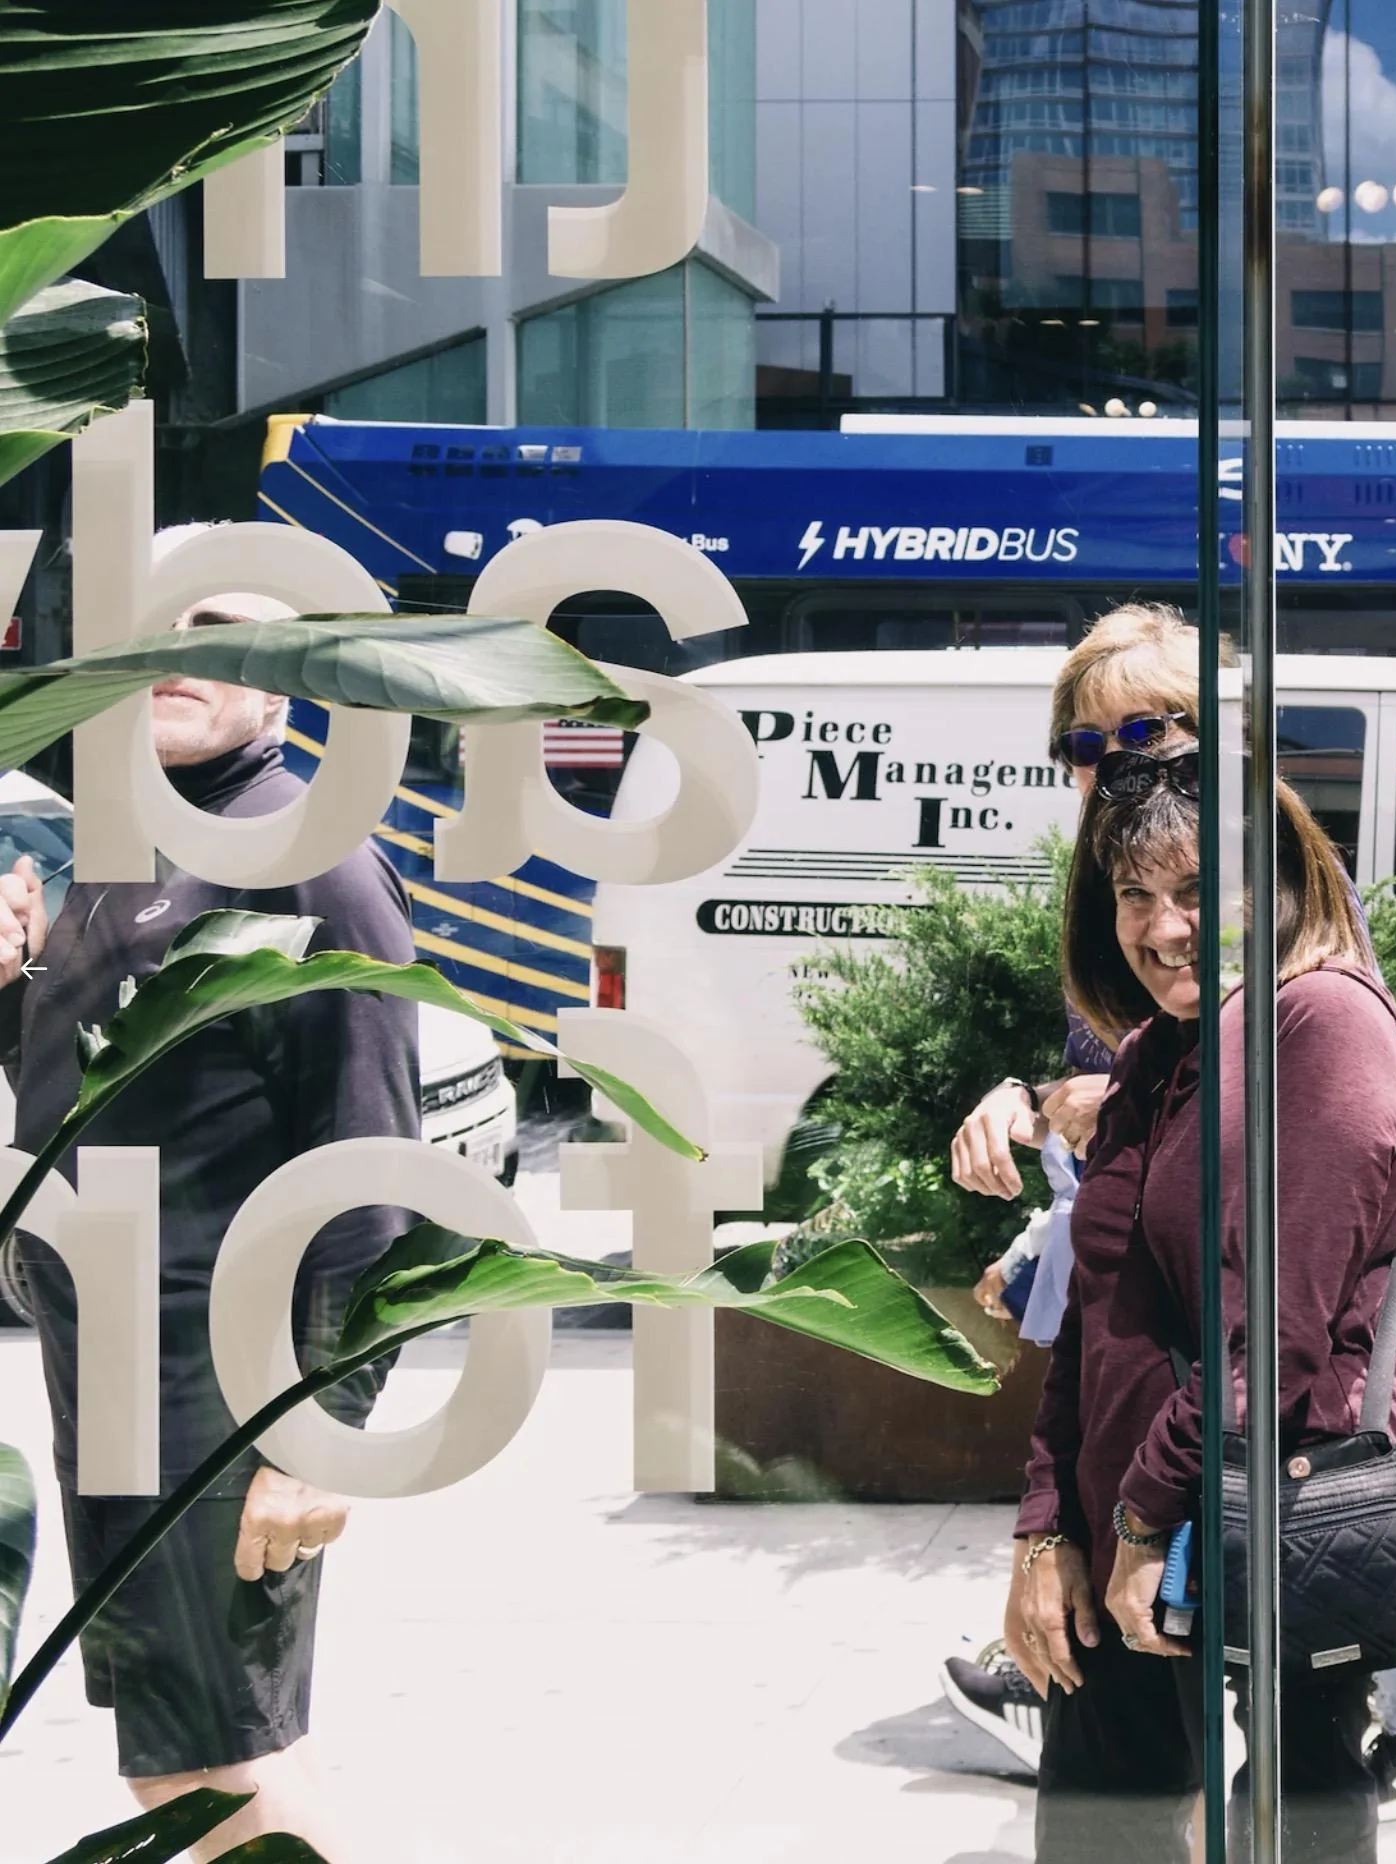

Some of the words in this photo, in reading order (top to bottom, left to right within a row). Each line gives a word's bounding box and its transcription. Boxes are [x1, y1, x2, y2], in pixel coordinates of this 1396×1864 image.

[832, 525, 1081, 563] HYBRIDBUS
[737, 708, 893, 760] Piece
[911, 796, 1014, 849] Inc.
